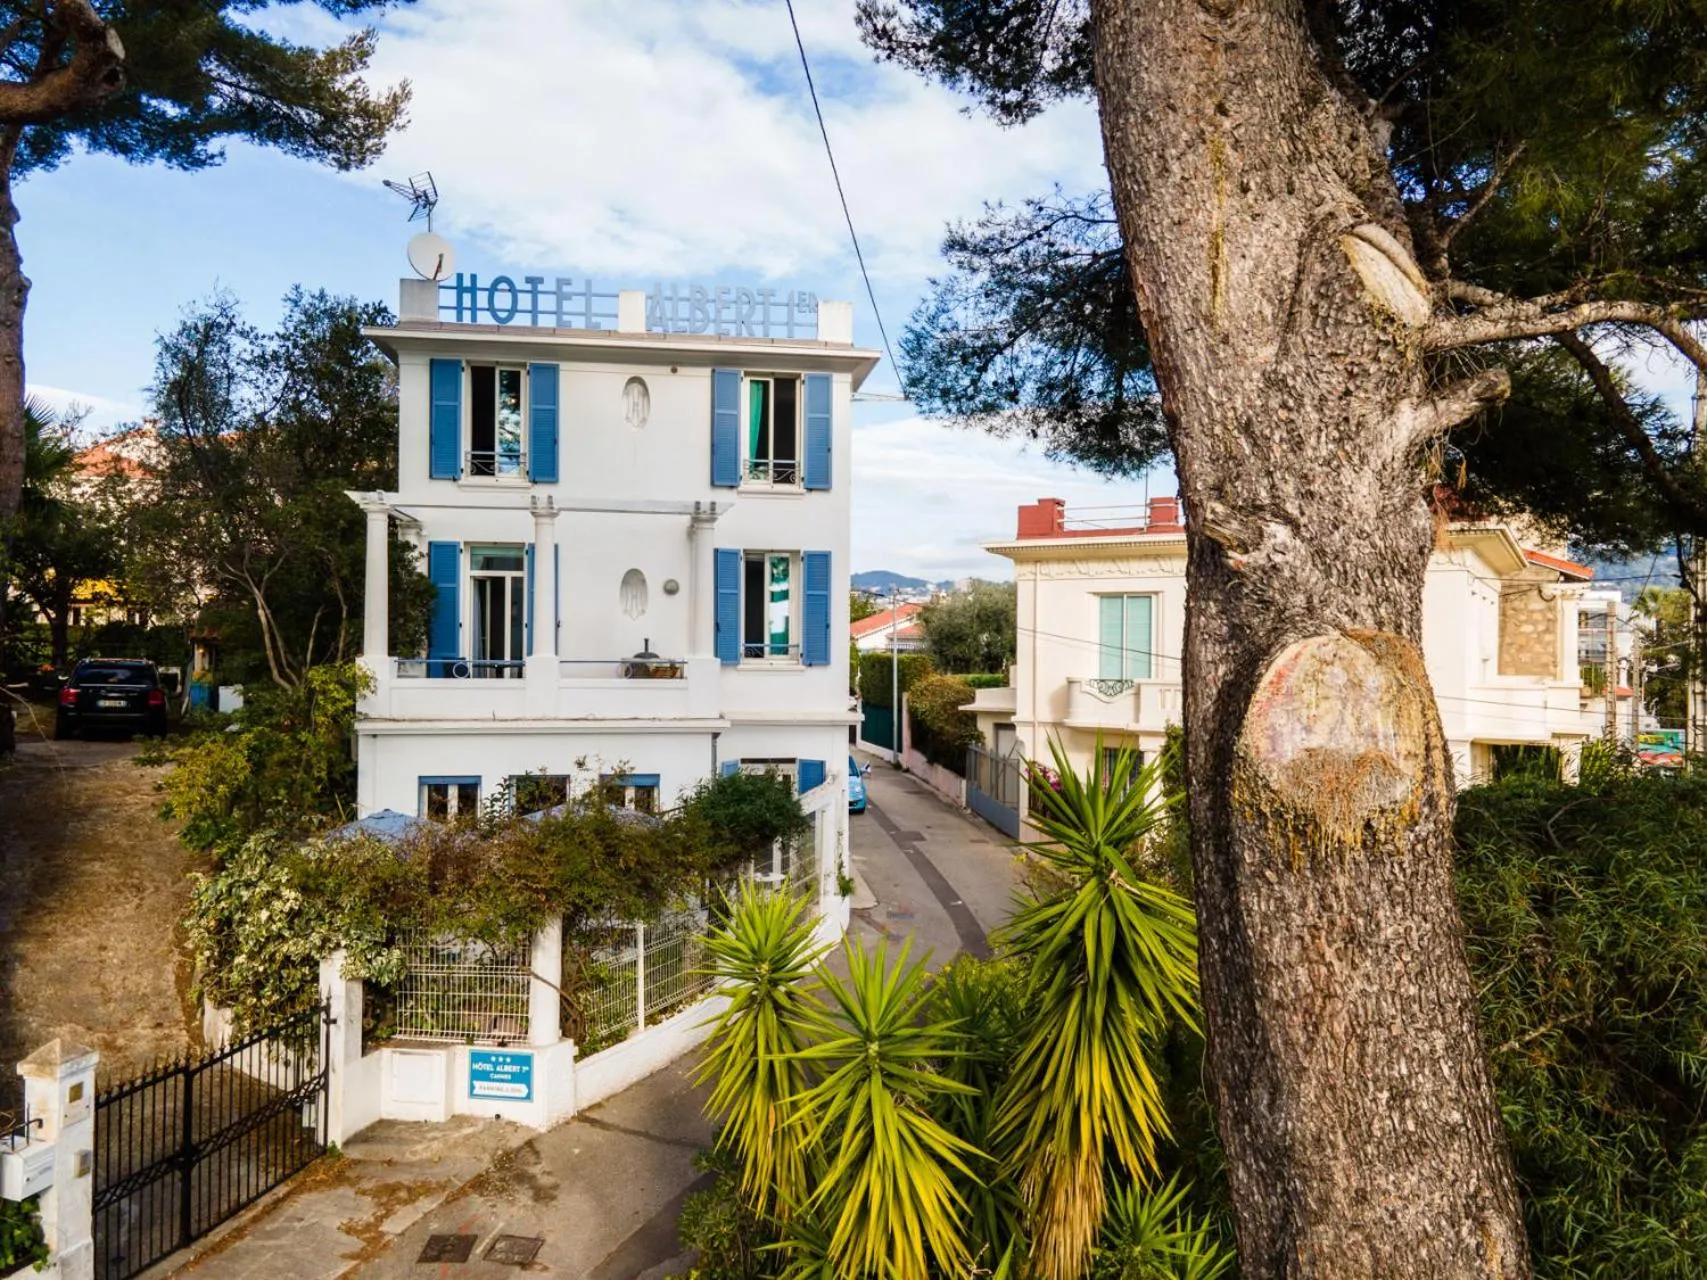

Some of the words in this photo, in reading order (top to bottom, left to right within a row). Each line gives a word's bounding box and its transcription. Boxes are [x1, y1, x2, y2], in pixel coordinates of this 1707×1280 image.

[456, 272, 601, 329] HOTEL
[645, 281, 777, 337] ALBERT
[496, 1064, 521, 1073] ALBERT
